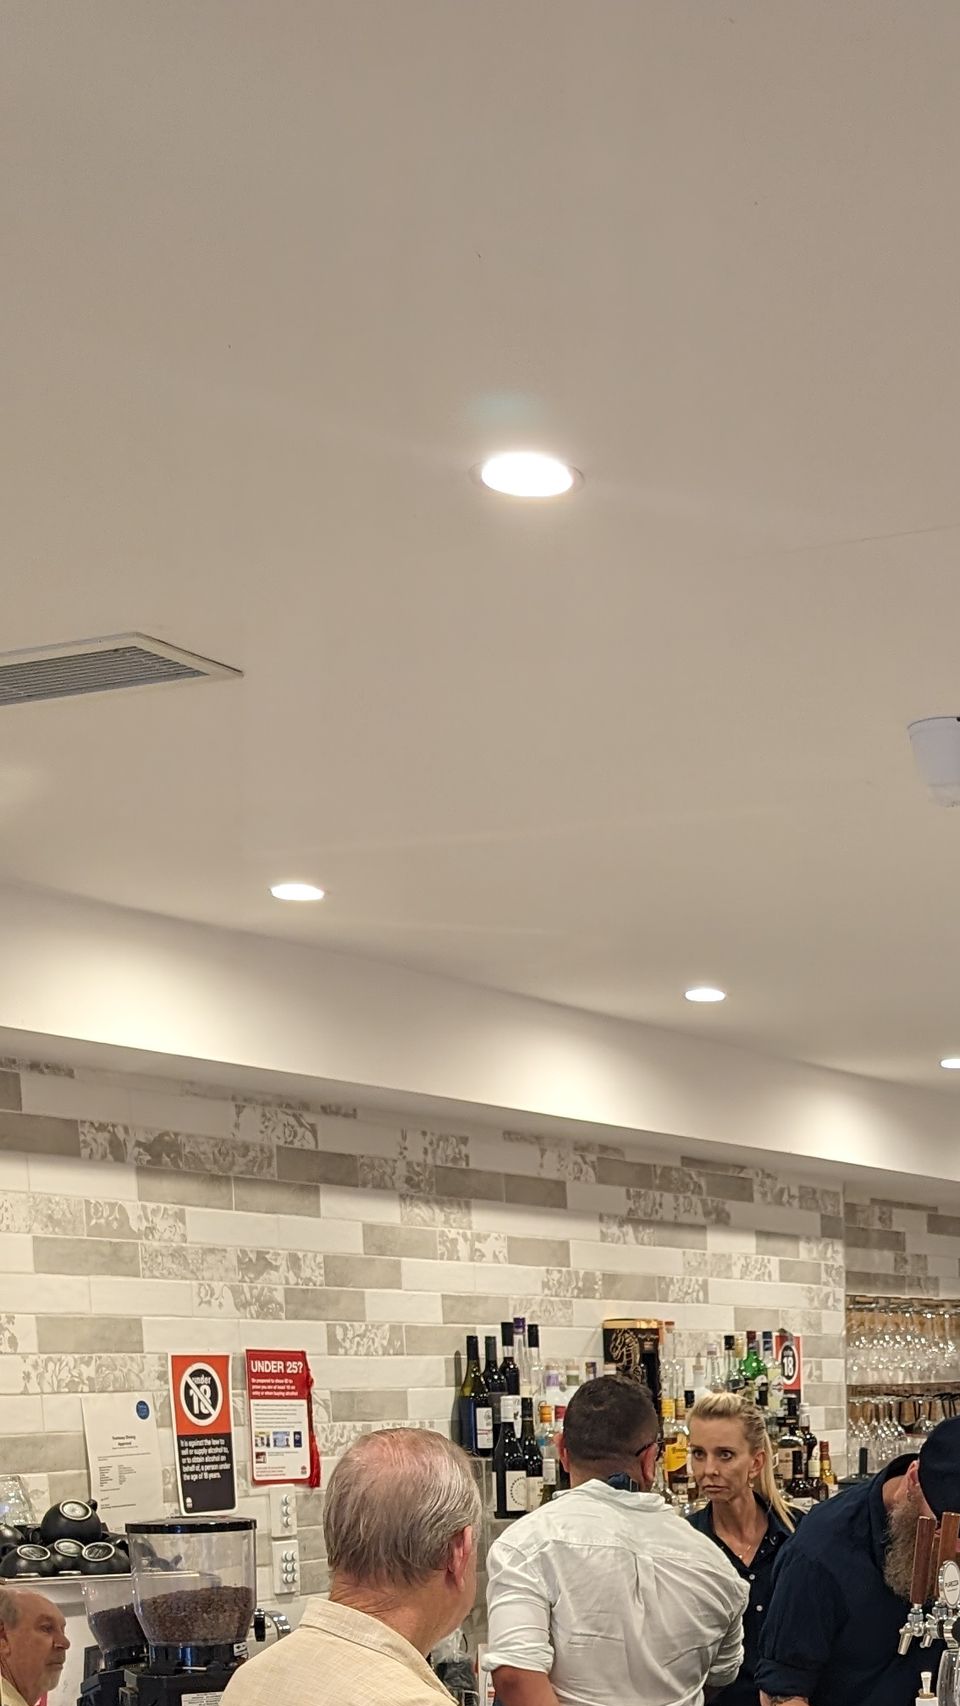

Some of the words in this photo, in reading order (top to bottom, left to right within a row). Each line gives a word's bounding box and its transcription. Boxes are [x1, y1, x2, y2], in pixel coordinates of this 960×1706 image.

[251, 1360, 284, 1373] UNDER
[286, 1361, 303, 1374] 25?
[783, 1357, 793, 1376] 18
[189, 1384, 212, 1414] 18
